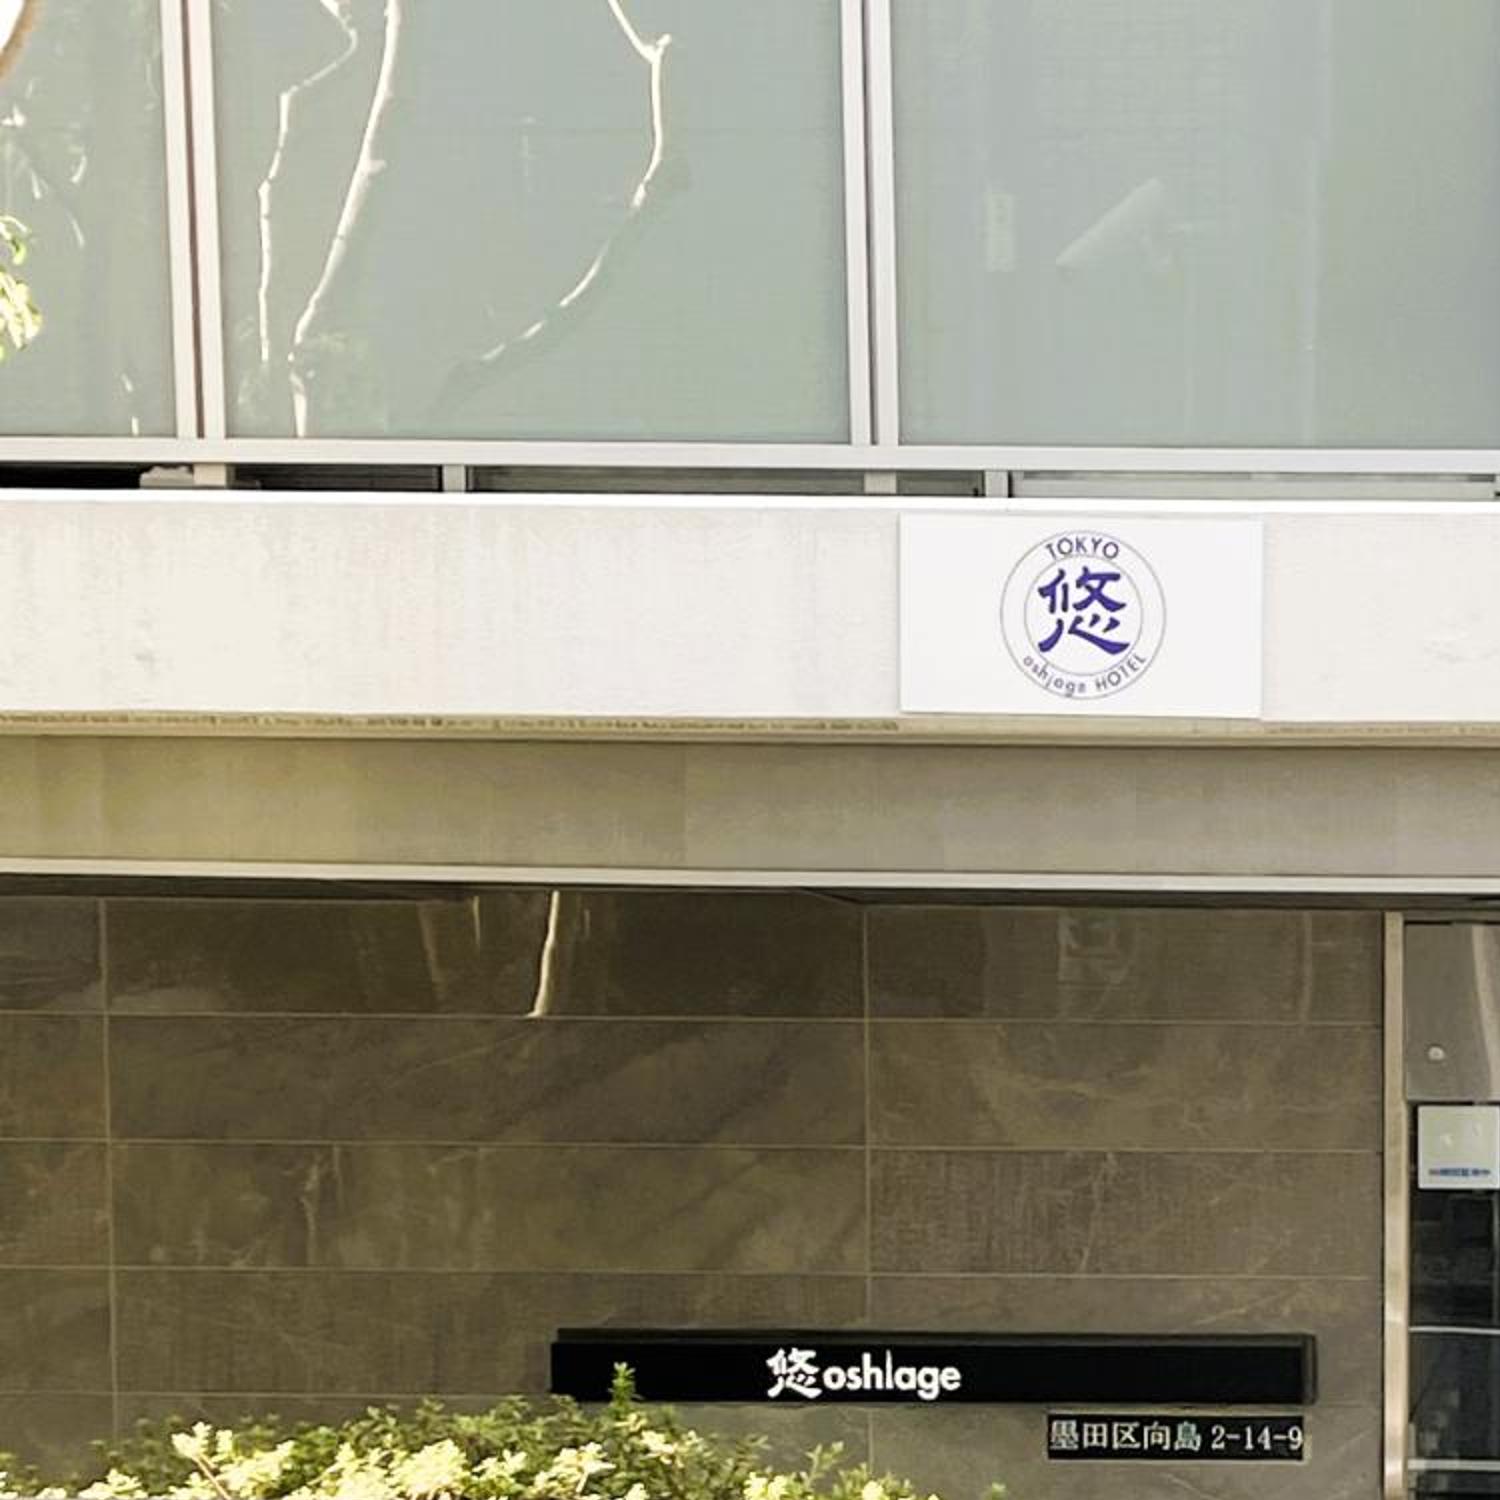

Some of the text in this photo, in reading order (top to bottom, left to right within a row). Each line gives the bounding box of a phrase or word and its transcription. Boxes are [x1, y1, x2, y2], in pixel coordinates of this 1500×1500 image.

[1046, 536, 1121, 560] TOKYO
[1037, 565, 1131, 656] 悠
[1095, 652, 1146, 692] HOTEL
[766, 1347, 823, 1399] 悠
[1050, 1419, 1303, 1451] 墨田区向島 2-14-9
